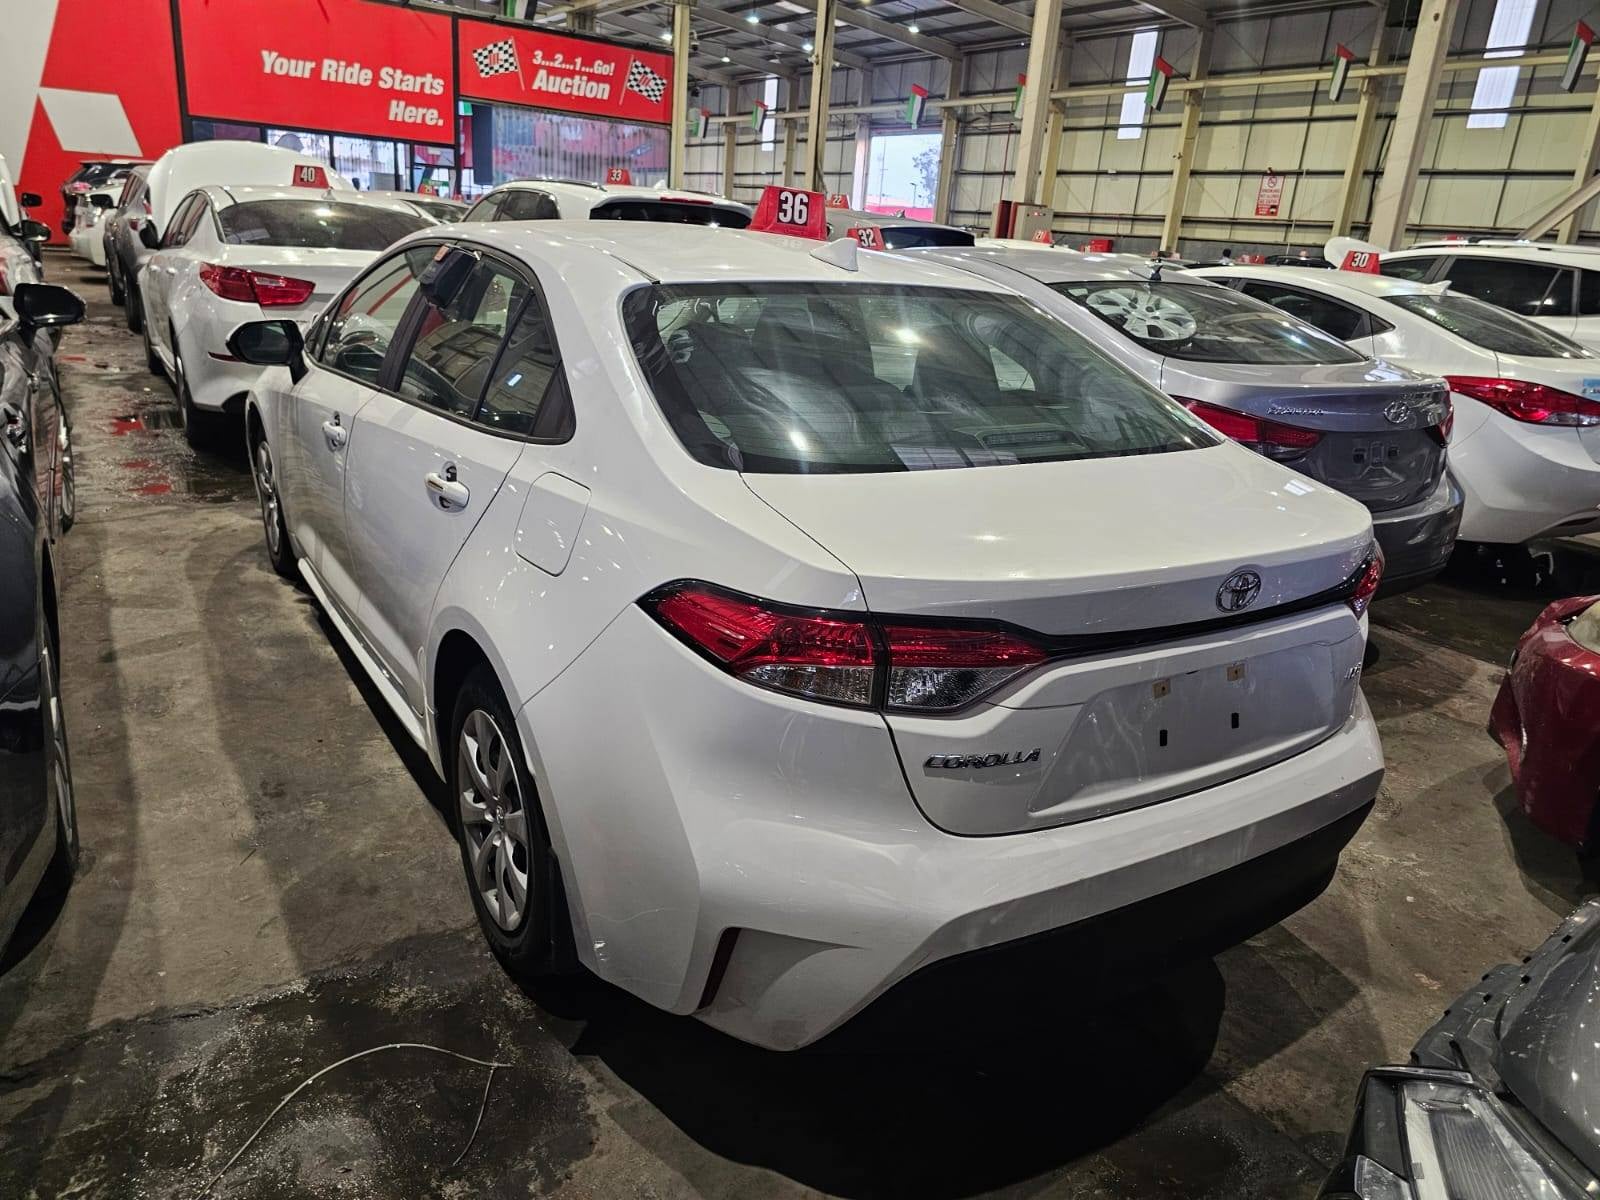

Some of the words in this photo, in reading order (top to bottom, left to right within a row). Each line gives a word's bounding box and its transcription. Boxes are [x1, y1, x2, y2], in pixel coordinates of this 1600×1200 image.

[261, 49, 316, 79] Your
[320, 58, 373, 86] Ride
[378, 66, 445, 96] Starts
[531, 69, 611, 100] Auction
[388, 99, 444, 127] Here.
[300, 167, 316, 183] 40
[610, 169, 622, 181] 33
[778, 190, 809, 225] 36
[857, 229, 877, 247] 32
[1351, 252, 1370, 268] 30
[923, 747, 1041, 769] COROLLA
